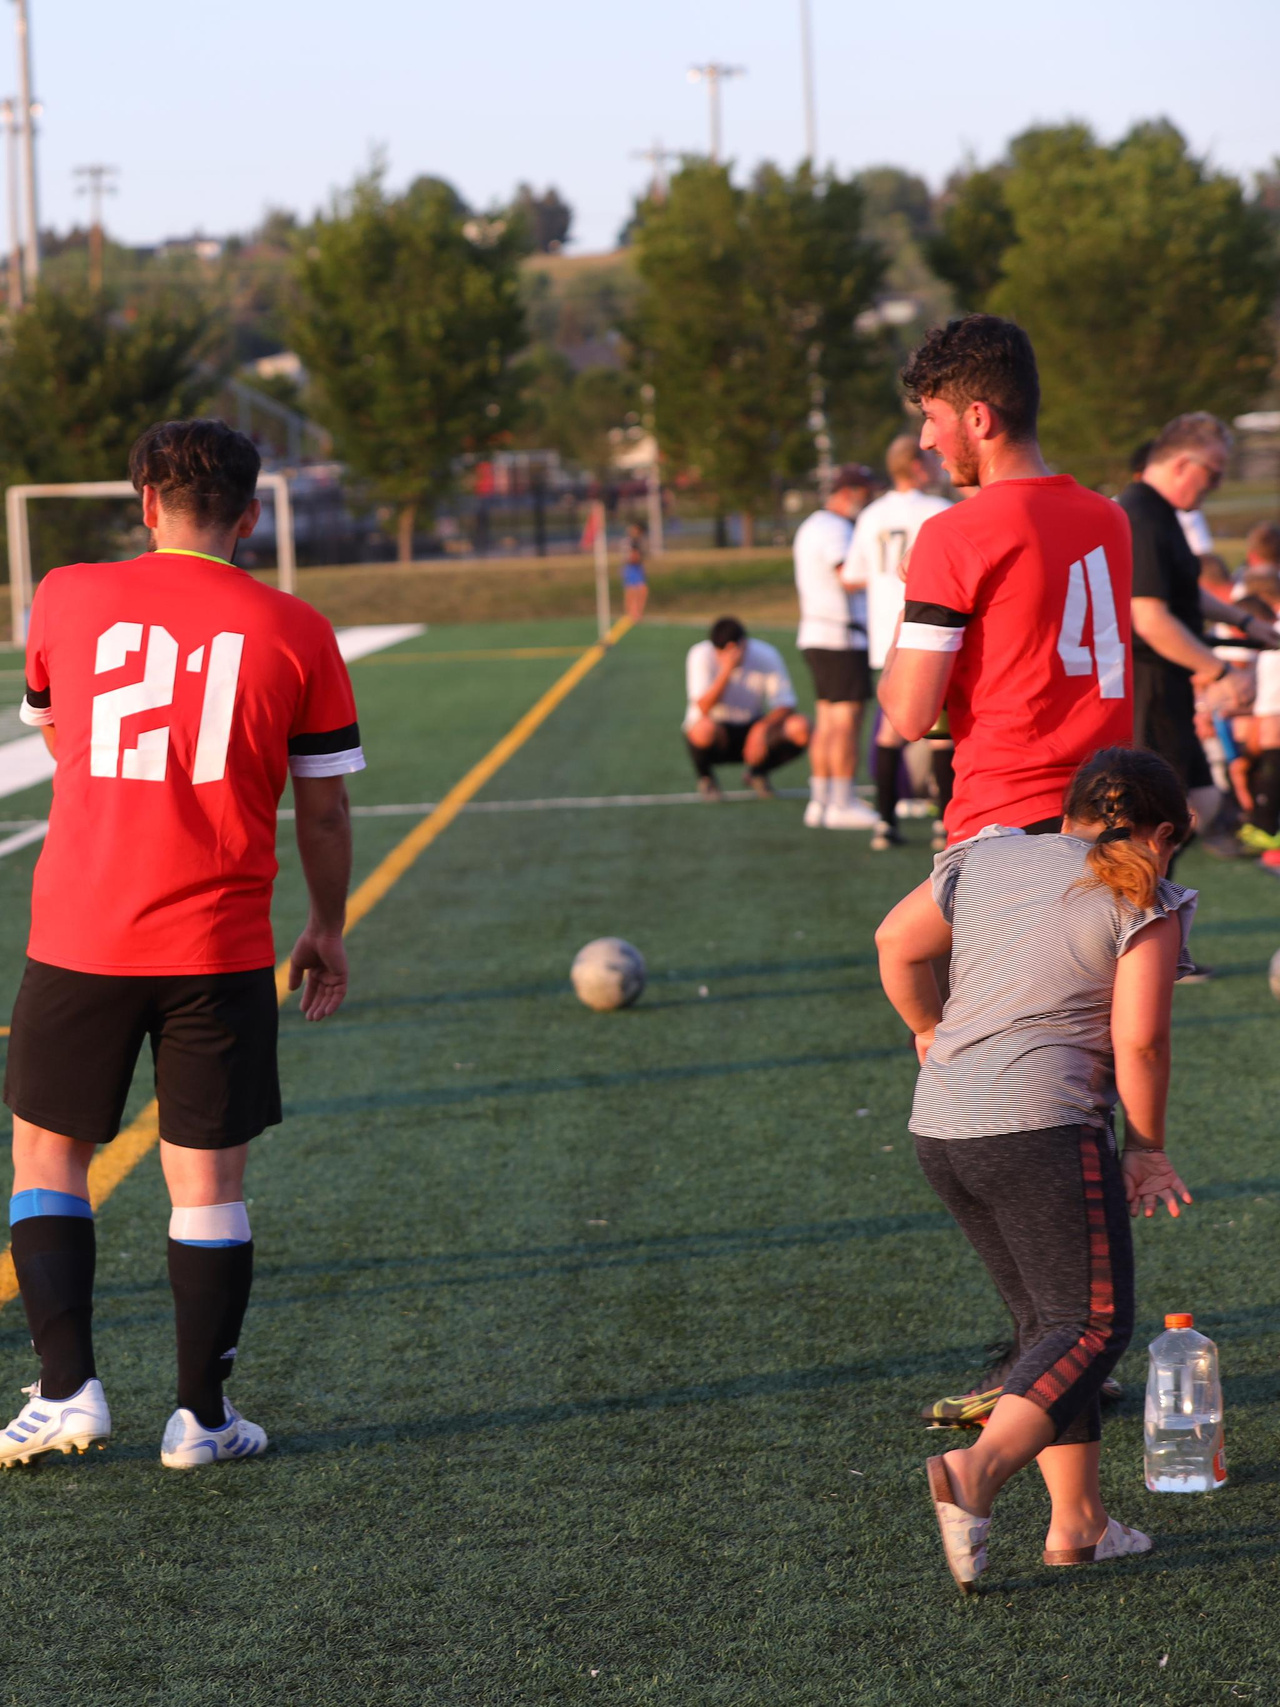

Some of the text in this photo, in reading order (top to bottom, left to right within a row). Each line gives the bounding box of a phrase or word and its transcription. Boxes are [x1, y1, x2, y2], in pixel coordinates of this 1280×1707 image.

[877, 528, 908, 573] 17
[1056, 545, 1125, 698] 4
[90, 621, 245, 785] 21
